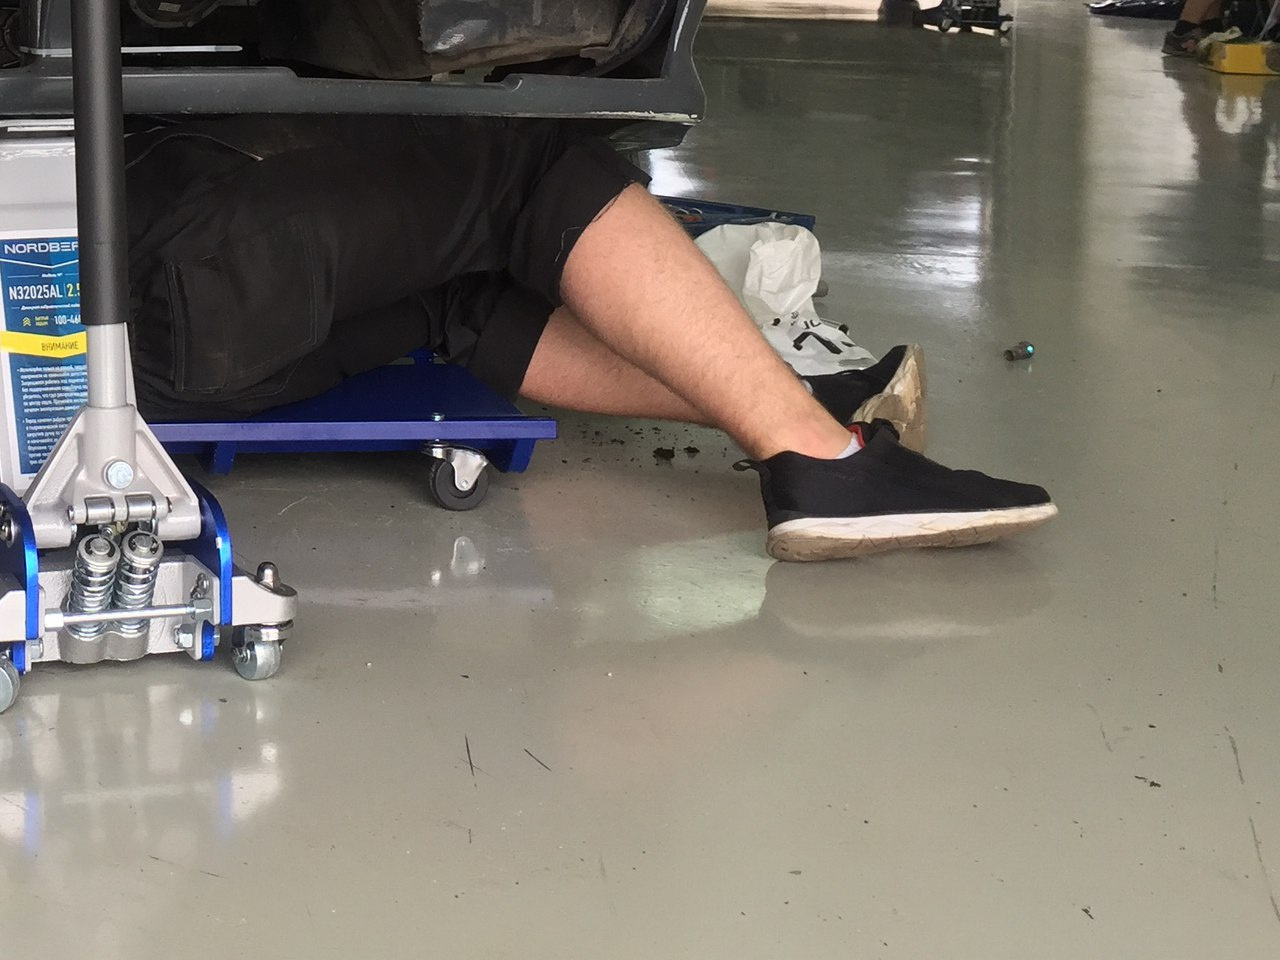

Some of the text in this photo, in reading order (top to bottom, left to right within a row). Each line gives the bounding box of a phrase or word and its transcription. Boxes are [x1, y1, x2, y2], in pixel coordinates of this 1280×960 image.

[4, 242, 79, 254] NORDBER
[9, 284, 63, 300] N32025AL
[41, 341, 79, 351] ВНИМАНИЕ
